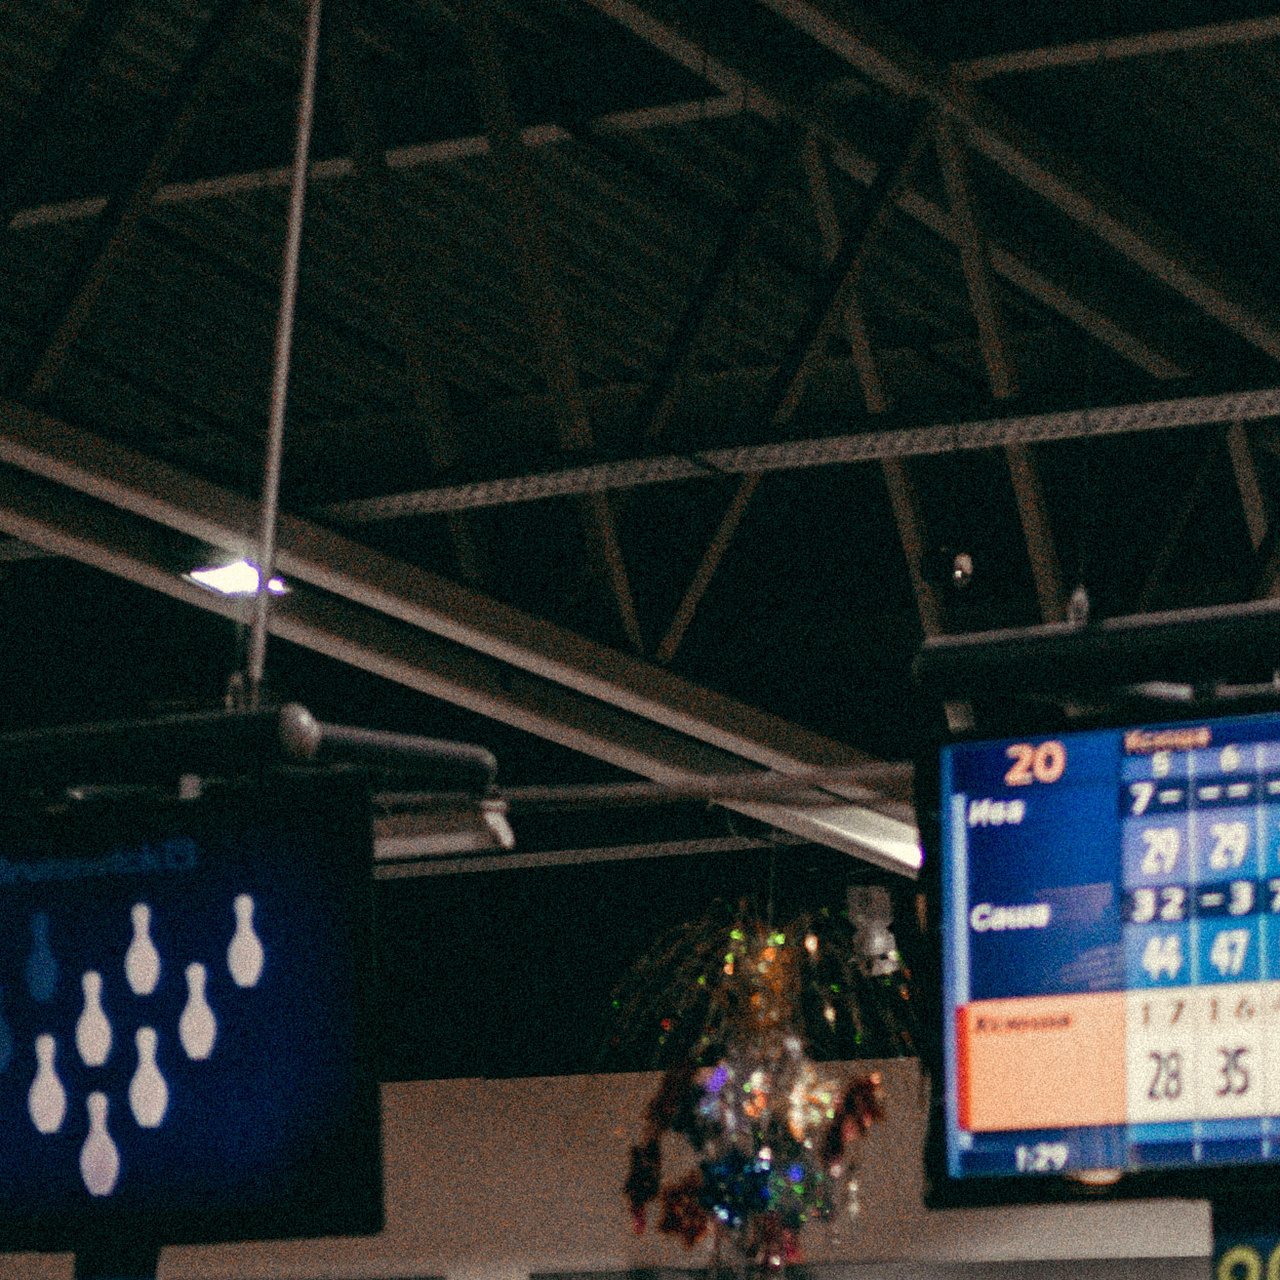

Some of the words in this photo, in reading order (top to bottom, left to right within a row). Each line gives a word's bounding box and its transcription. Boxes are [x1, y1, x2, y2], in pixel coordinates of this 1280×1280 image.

[1004, 740, 1067, 786] 20
[1141, 826, 1181, 875] 29
[1210, 821, 1250, 870] 29
[1149, 1051, 1182, 1100] 28
[1216, 1047, 1249, 1096] 35
